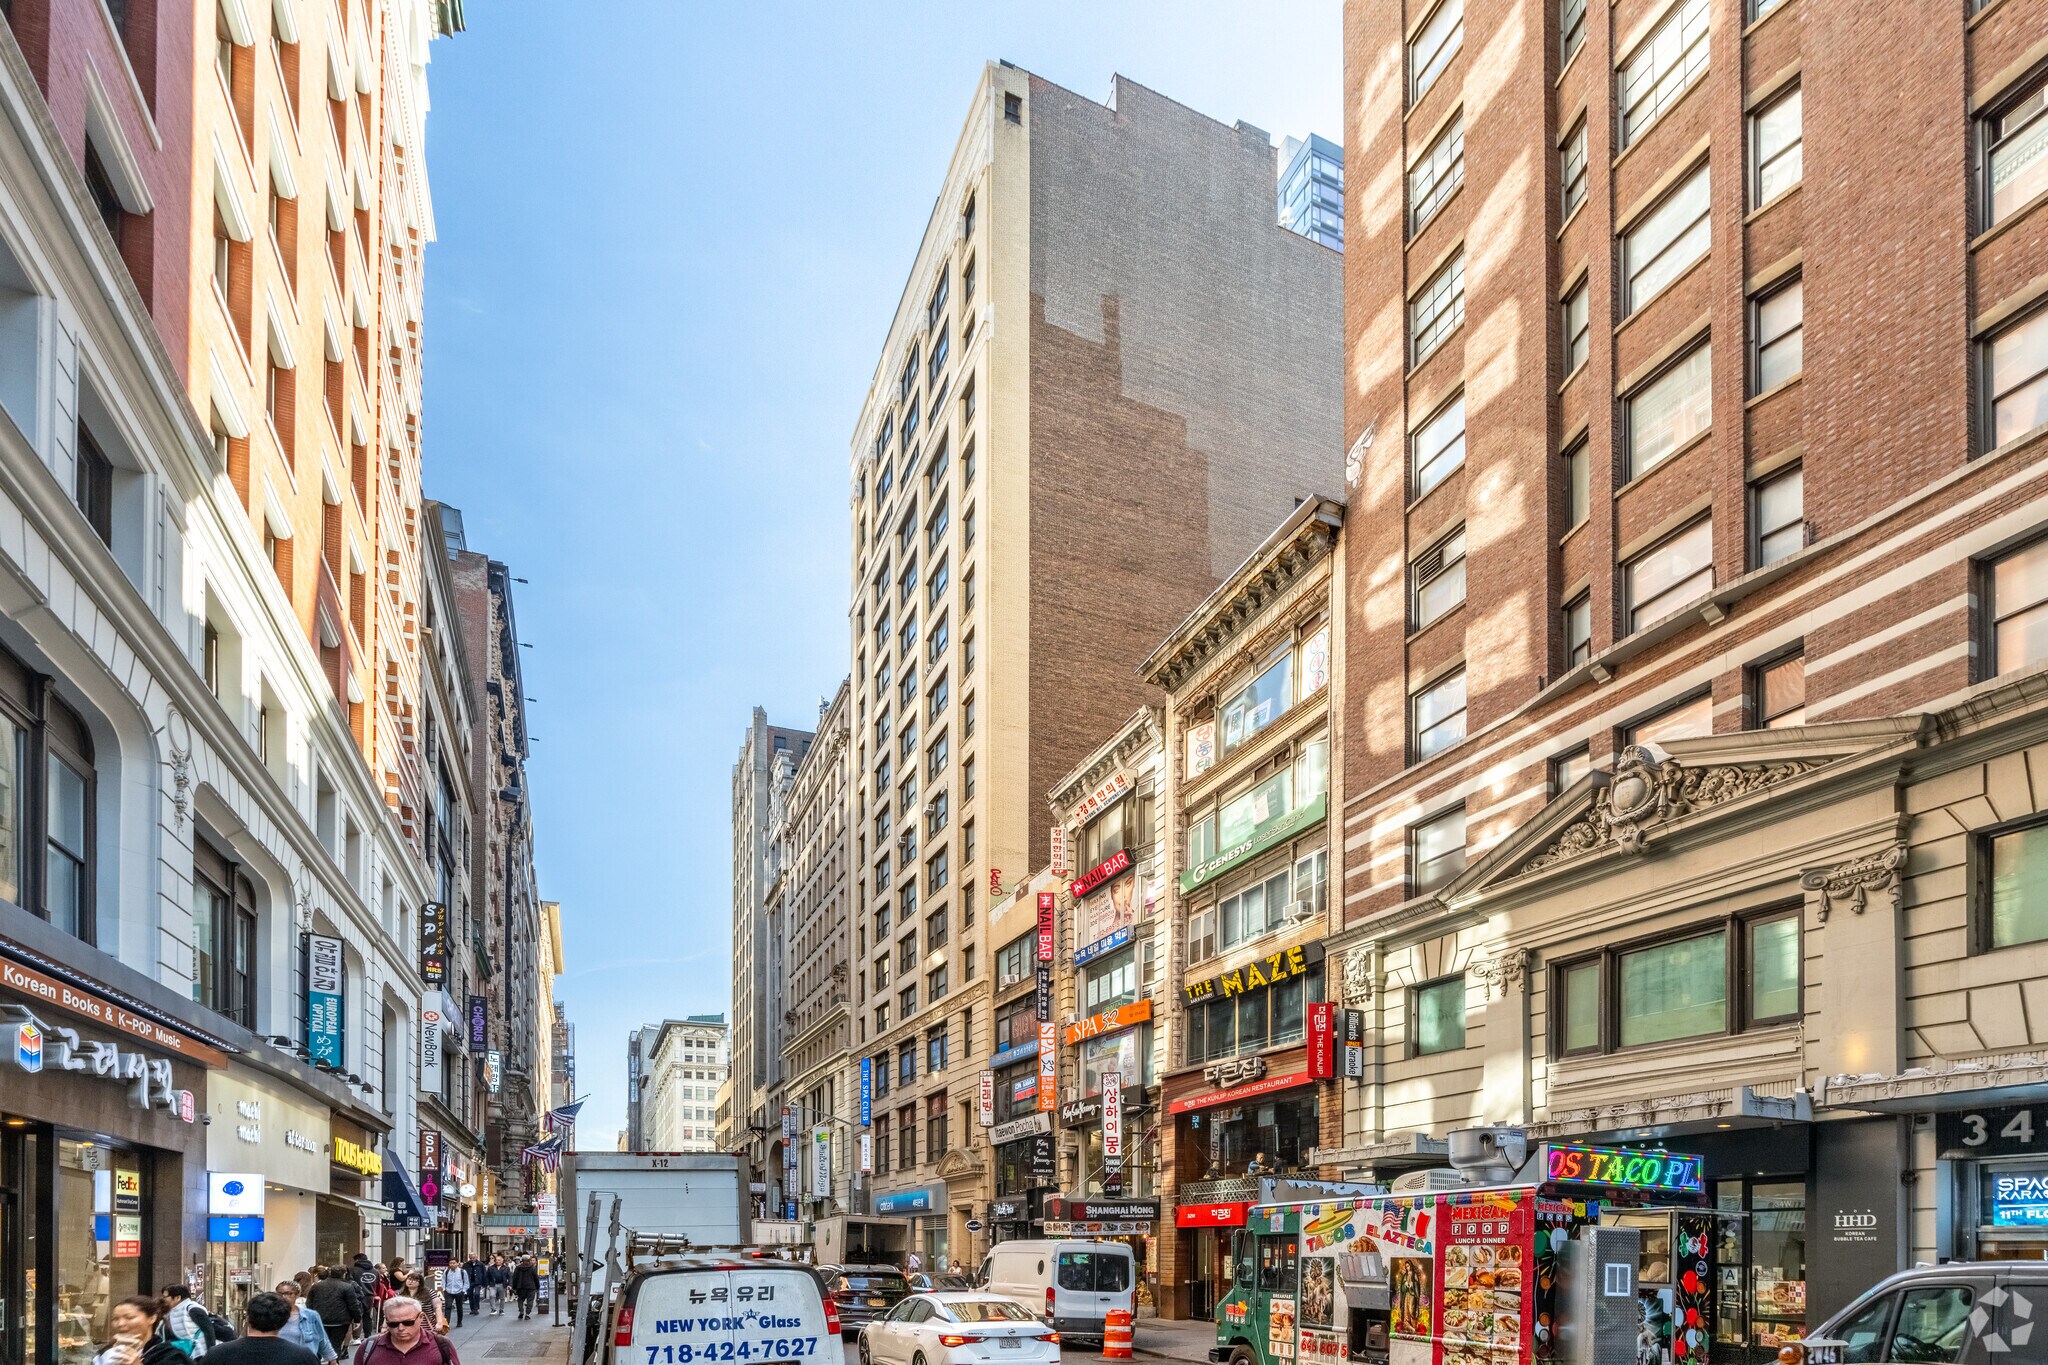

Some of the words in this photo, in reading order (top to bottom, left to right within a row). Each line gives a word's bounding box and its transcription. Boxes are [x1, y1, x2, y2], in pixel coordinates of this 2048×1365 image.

[1248, 580, 1307, 640] BUILDING
[1079, 774, 1126, 815] 경희한의원
[1104, 786, 1129, 807] ACUPUNCTURE
[1053, 828, 1062, 869] 경희한의원
[1208, 840, 1253, 871] GENESYS
[1082, 868, 1106, 890] NAIL
[1104, 853, 1128, 876] BAR
[424, 904, 437, 955] SPA
[1040, 908, 1051, 934] NAIL
[1040, 935, 1052, 958] BAR
[1186, 980, 1212, 998] THE
[1221, 944, 1306, 998] MAZE
[4, 964, 57, 999] Korean
[62, 988, 100, 1016] Books
[105, 1007, 114, 1022] &
[118, 1012, 152, 1036] K-POP
[156, 1028, 181, 1049] Music
[312, 1004, 324, 1033] OPTICAL
[326, 997, 338, 1036] EUROPEAN
[1314, 1006, 1326, 1032] 더큰집
[472, 1006, 485, 1042] CHORUS
[1074, 1016, 1098, 1042] SPA
[1100, 1010, 1120, 1032] 32
[1348, 1012, 1358, 1040] Billiards
[424, 1022, 438, 1068] NewBank
[1041, 1023, 1055, 1056] SPA
[58, 1026, 178, 1116] 고려서적
[490, 1056, 498, 1082] 노래방
[1042, 1059, 1054, 1073] 32
[1204, 1056, 1262, 1088] 더큰집
[1348, 1047, 1358, 1074] Karaoke
[982, 1078, 992, 1112] 노래방
[1042, 1096, 1054, 1106] 3rd
[1207, 1092, 1227, 1103] KUNJIP
[1227, 1086, 1251, 1098] KOREAN
[1252, 1076, 1293, 1092] RESTAURANT
[238, 1100, 260, 1120] machi
[1104, 1088, 1120, 1154] 상하이몽
[238, 1124, 260, 1144] machi
[994, 1123, 1016, 1138] Itaewon
[1015, 1118, 1034, 1132] Pocha
[335, 1136, 357, 1168] TOUS
[362, 1149, 382, 1175] JOURS
[425, 1136, 436, 1166] SPA
[652, 1159, 668, 1168] X-12
[820, 1163, 827, 1171] of
[1588, 1153, 1661, 1184] TACO
[1664, 1160, 1700, 1188] PL
[118, 1176, 138, 1191] FedEx
[818, 1171, 827, 1192] Hope
[1128, 1205, 1154, 1214] MONG
[1211, 1208, 1231, 1220] 더큰집
[1452, 1205, 1510, 1220] MEXICAN
[1536, 1212, 1572, 1222] FOOD
[1537, 1202, 1572, 1212] MEXICAN
[2000, 1210, 2022, 1219] 11TH
[1452, 1222, 1509, 1236] FOOD
[1834, 1214, 1877, 1227] HHD
[1306, 1222, 1356, 1253] TACOS
[1366, 1224, 1381, 1239] EL
[1382, 1229, 1433, 1256] AZTECA
[1726, 1270, 1735, 1280] A
[689, 1286, 728, 1304] 뉴욕
[736, 1286, 774, 1302] 유리
[656, 1318, 694, 1334] NEW
[697, 1317, 745, 1332] YORK
[758, 1316, 801, 1329] Glass
[645, 1336, 818, 1365] 718-424-7627
[1340, 1344, 1348, 1358] 5
